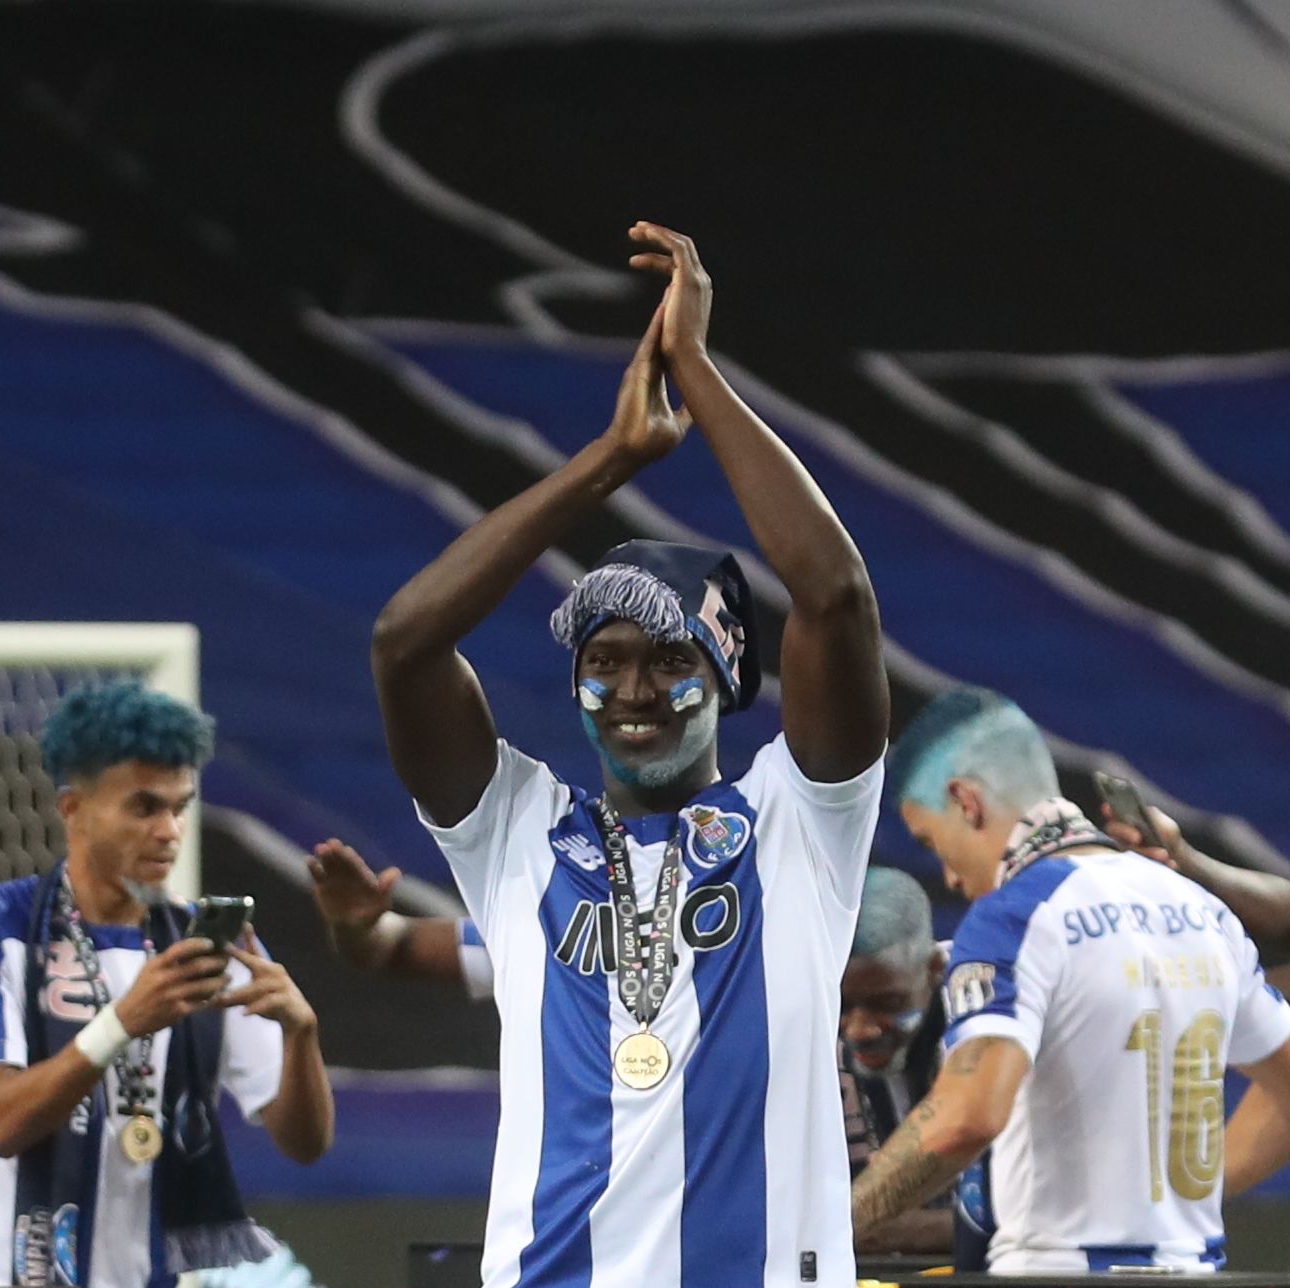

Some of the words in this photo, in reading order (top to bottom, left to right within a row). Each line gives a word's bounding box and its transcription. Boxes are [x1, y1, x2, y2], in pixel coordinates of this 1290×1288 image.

[615, 861, 628, 884] LIGA
[661, 866, 672, 892] LIGA
[618, 895, 636, 927] NOS
[654, 894, 672, 929] NOS
[625, 931, 636, 957] LIGA
[654, 942, 665, 969] LIGA
[621, 971, 641, 1006] NOS
[649, 973, 666, 1008] NOS
